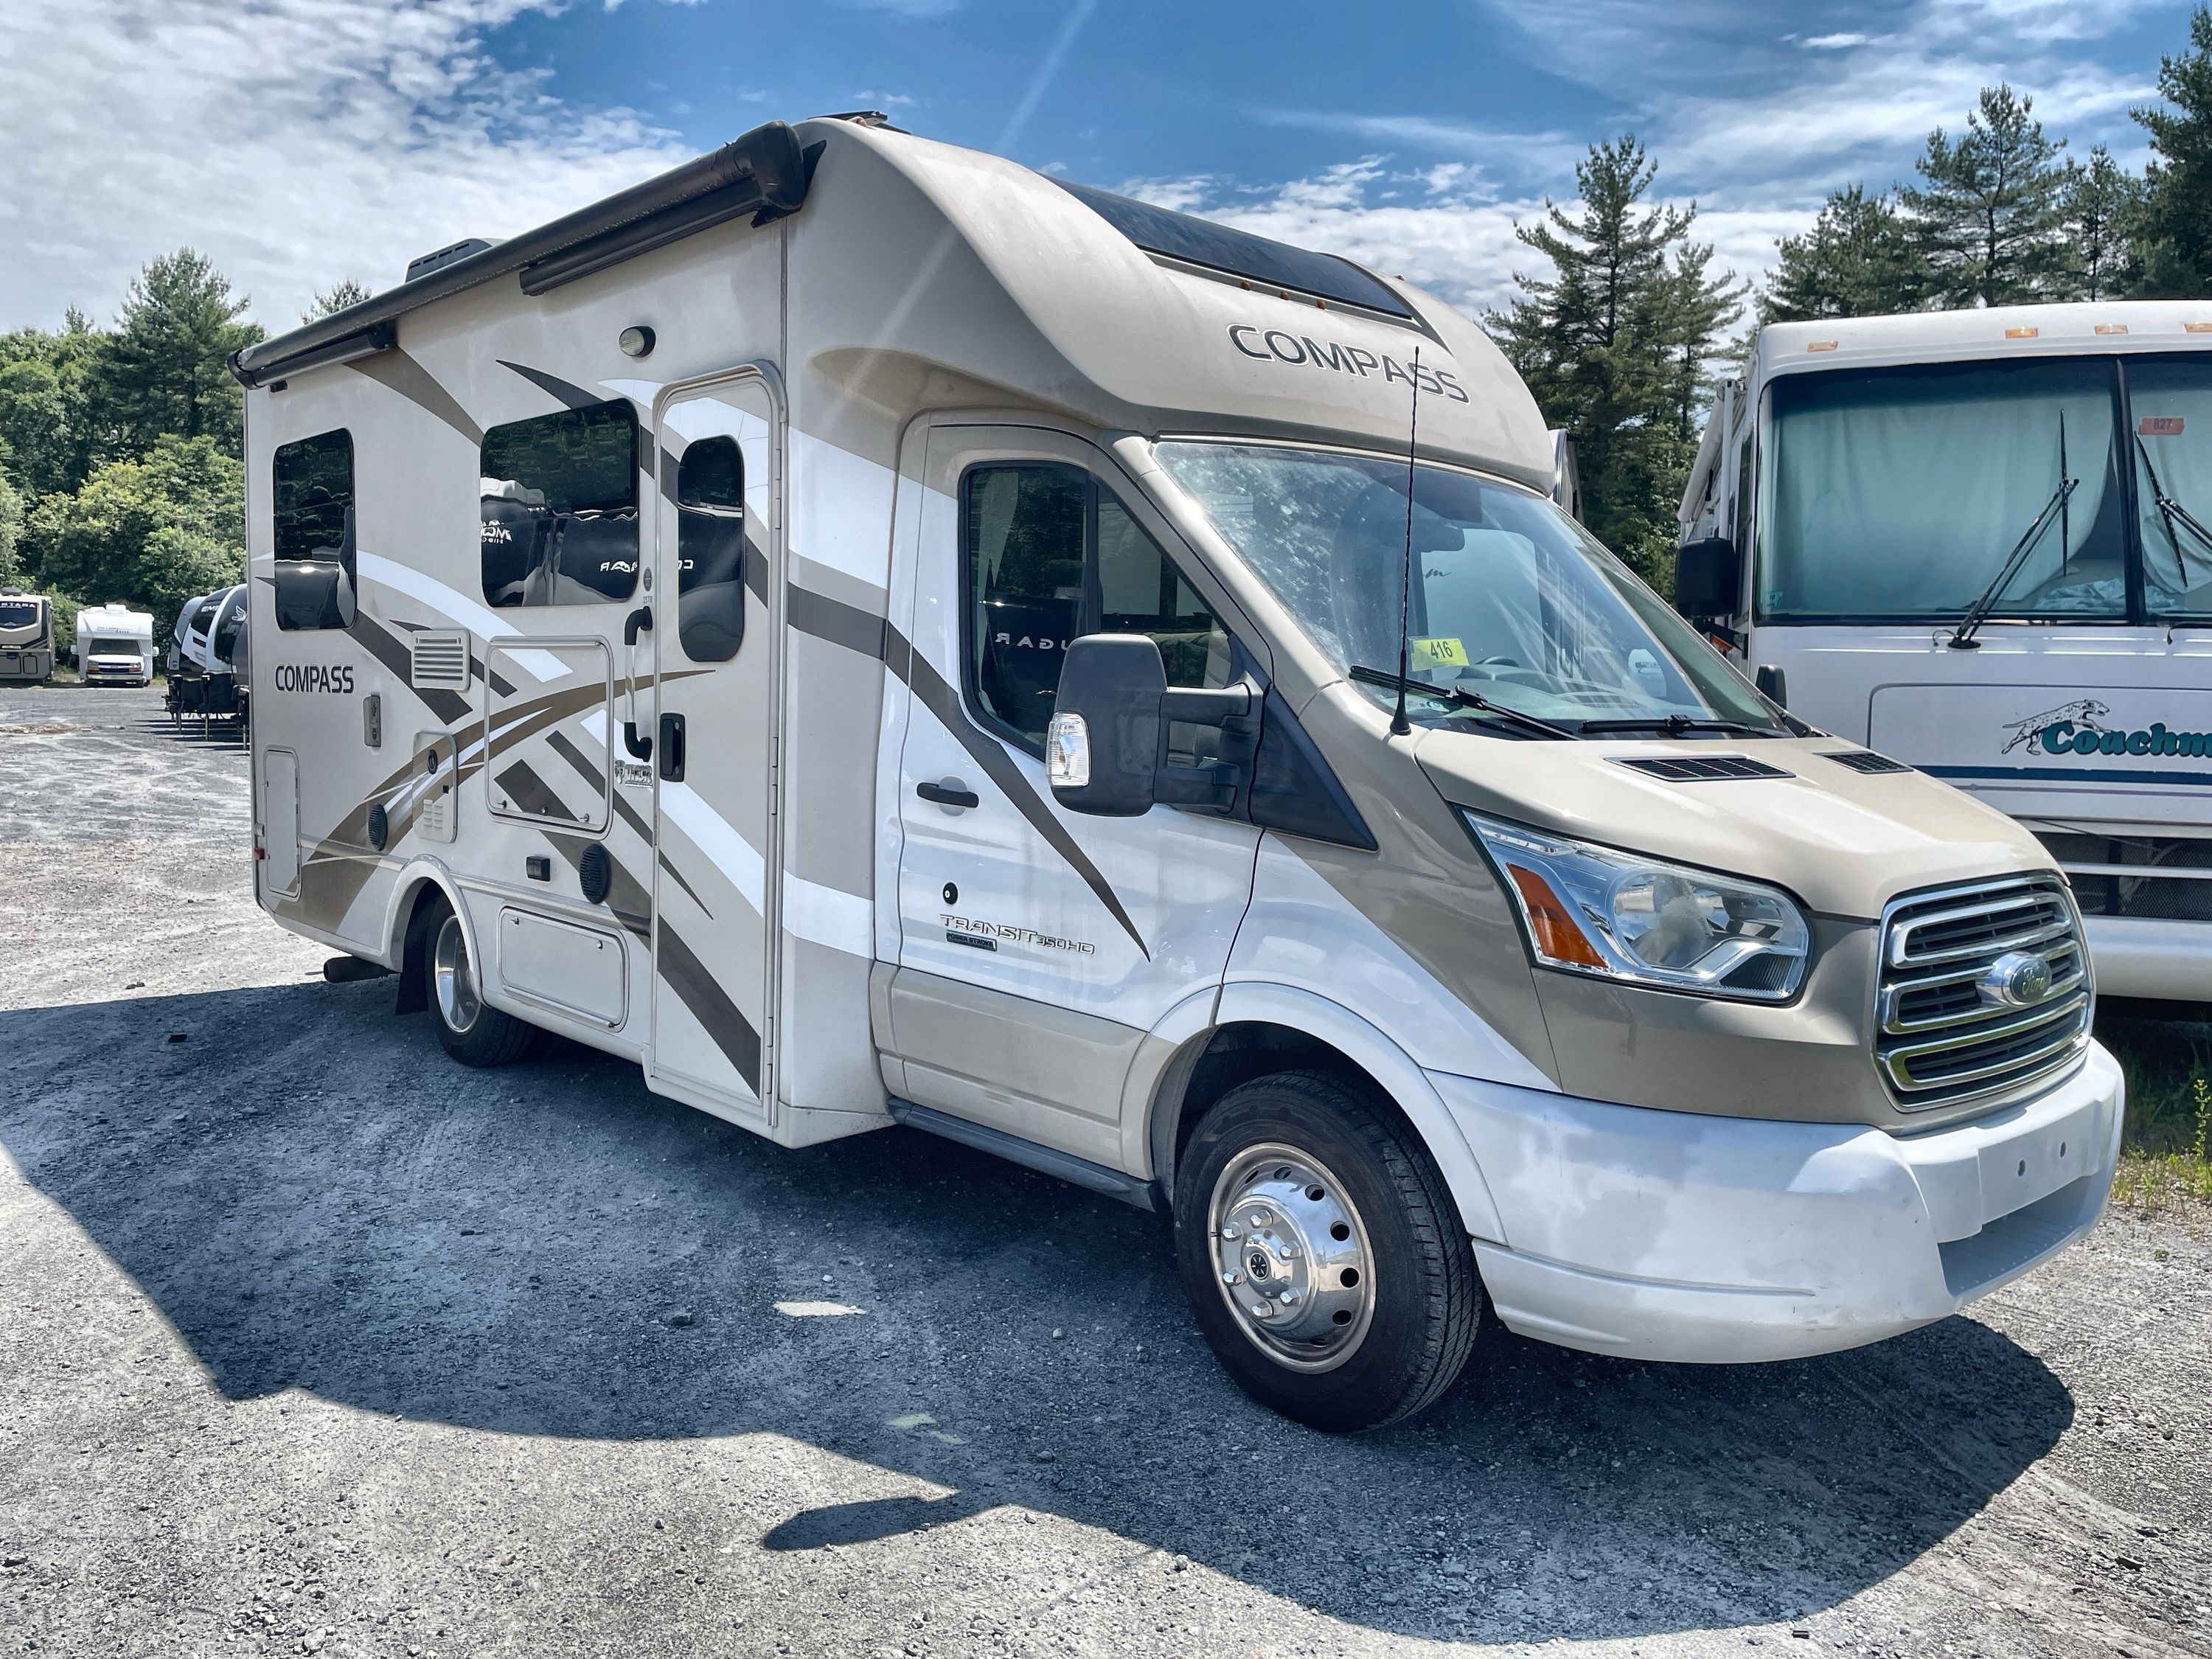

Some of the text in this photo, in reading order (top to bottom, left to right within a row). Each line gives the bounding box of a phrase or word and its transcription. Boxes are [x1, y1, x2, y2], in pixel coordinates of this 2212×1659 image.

[1227, 324, 1471, 404] COMPASS
[2153, 418, 2172, 430] 827
[1430, 641, 1453, 660] 416
[275, 665, 355, 694] COMPASS
[939, 914, 1037, 943] TRANSIT
[947, 932, 994, 947] POWER STROKE
[2022, 967, 2046, 995] Ford
